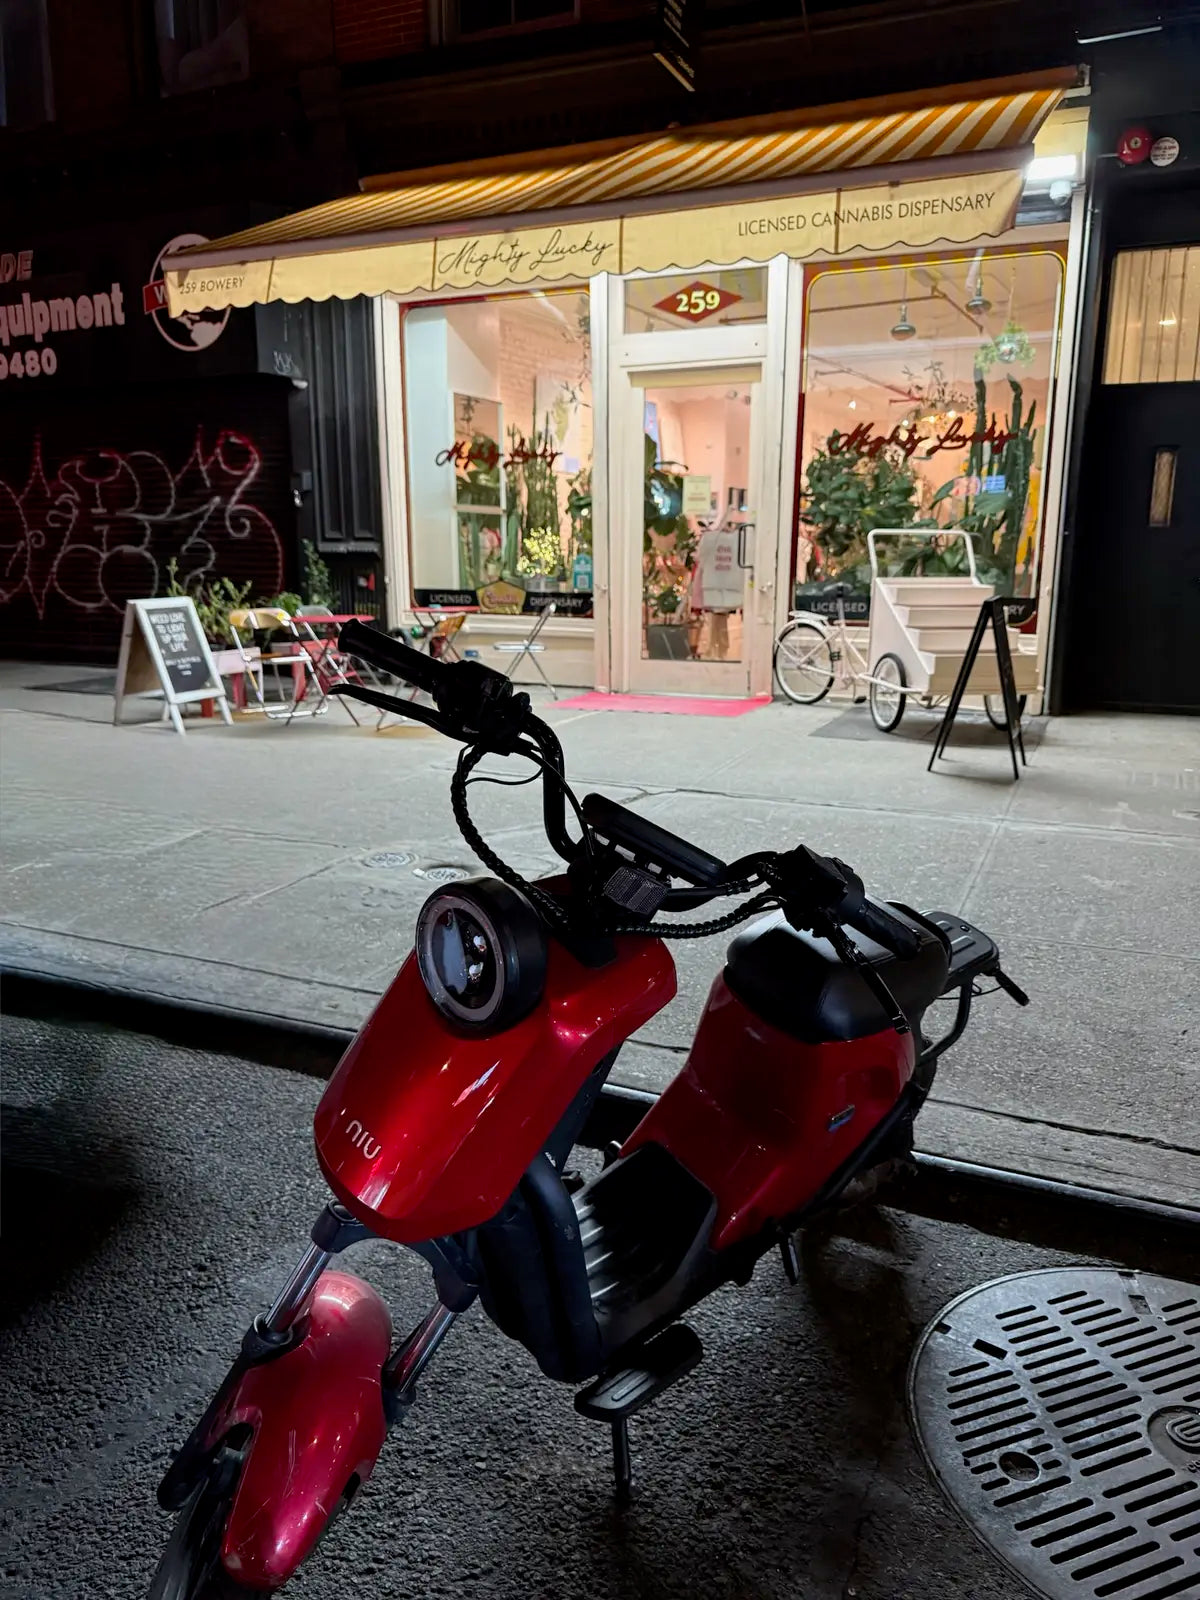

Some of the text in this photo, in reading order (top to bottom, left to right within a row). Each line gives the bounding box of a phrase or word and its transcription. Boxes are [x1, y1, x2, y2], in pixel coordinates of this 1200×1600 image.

[738, 192, 996, 236] LICENSED CANNABIS DISPENSARY
[438, 229, 614, 277] Mighty Lucky
[179, 276, 246, 295] 259 BOWERY
[676, 290, 720, 314] 259
[429, 594, 472, 605] LICENSED
[810, 601, 867, 613] LICESED
